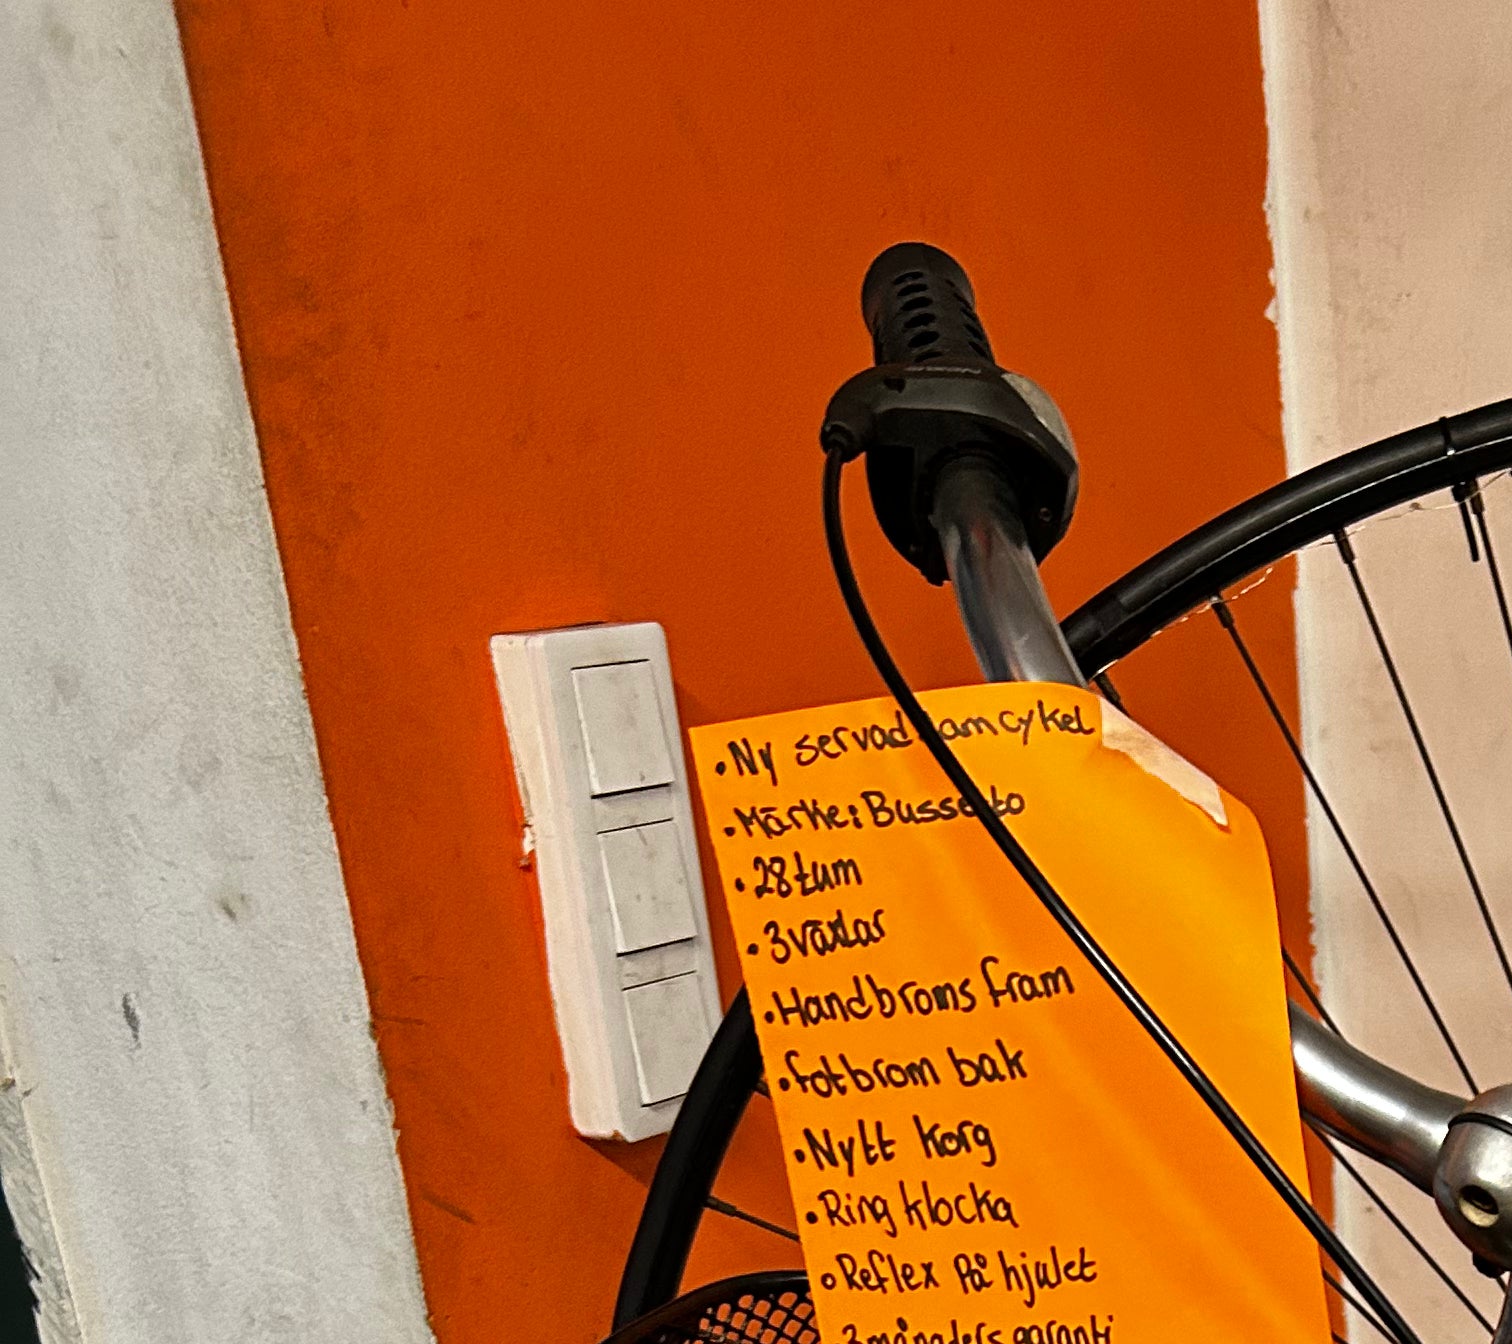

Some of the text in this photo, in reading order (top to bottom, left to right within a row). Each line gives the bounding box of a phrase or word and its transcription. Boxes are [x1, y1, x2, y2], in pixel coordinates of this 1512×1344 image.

[728, 699, 1096, 786] Ny servad amcykel
[980, 956, 1075, 1008] fram
[946, 1039, 1028, 1087] bak
[803, 1119, 897, 1178] Nytt
[836, 1249, 940, 1294] Reflex
[998, 1246, 1097, 1308] hjulet
